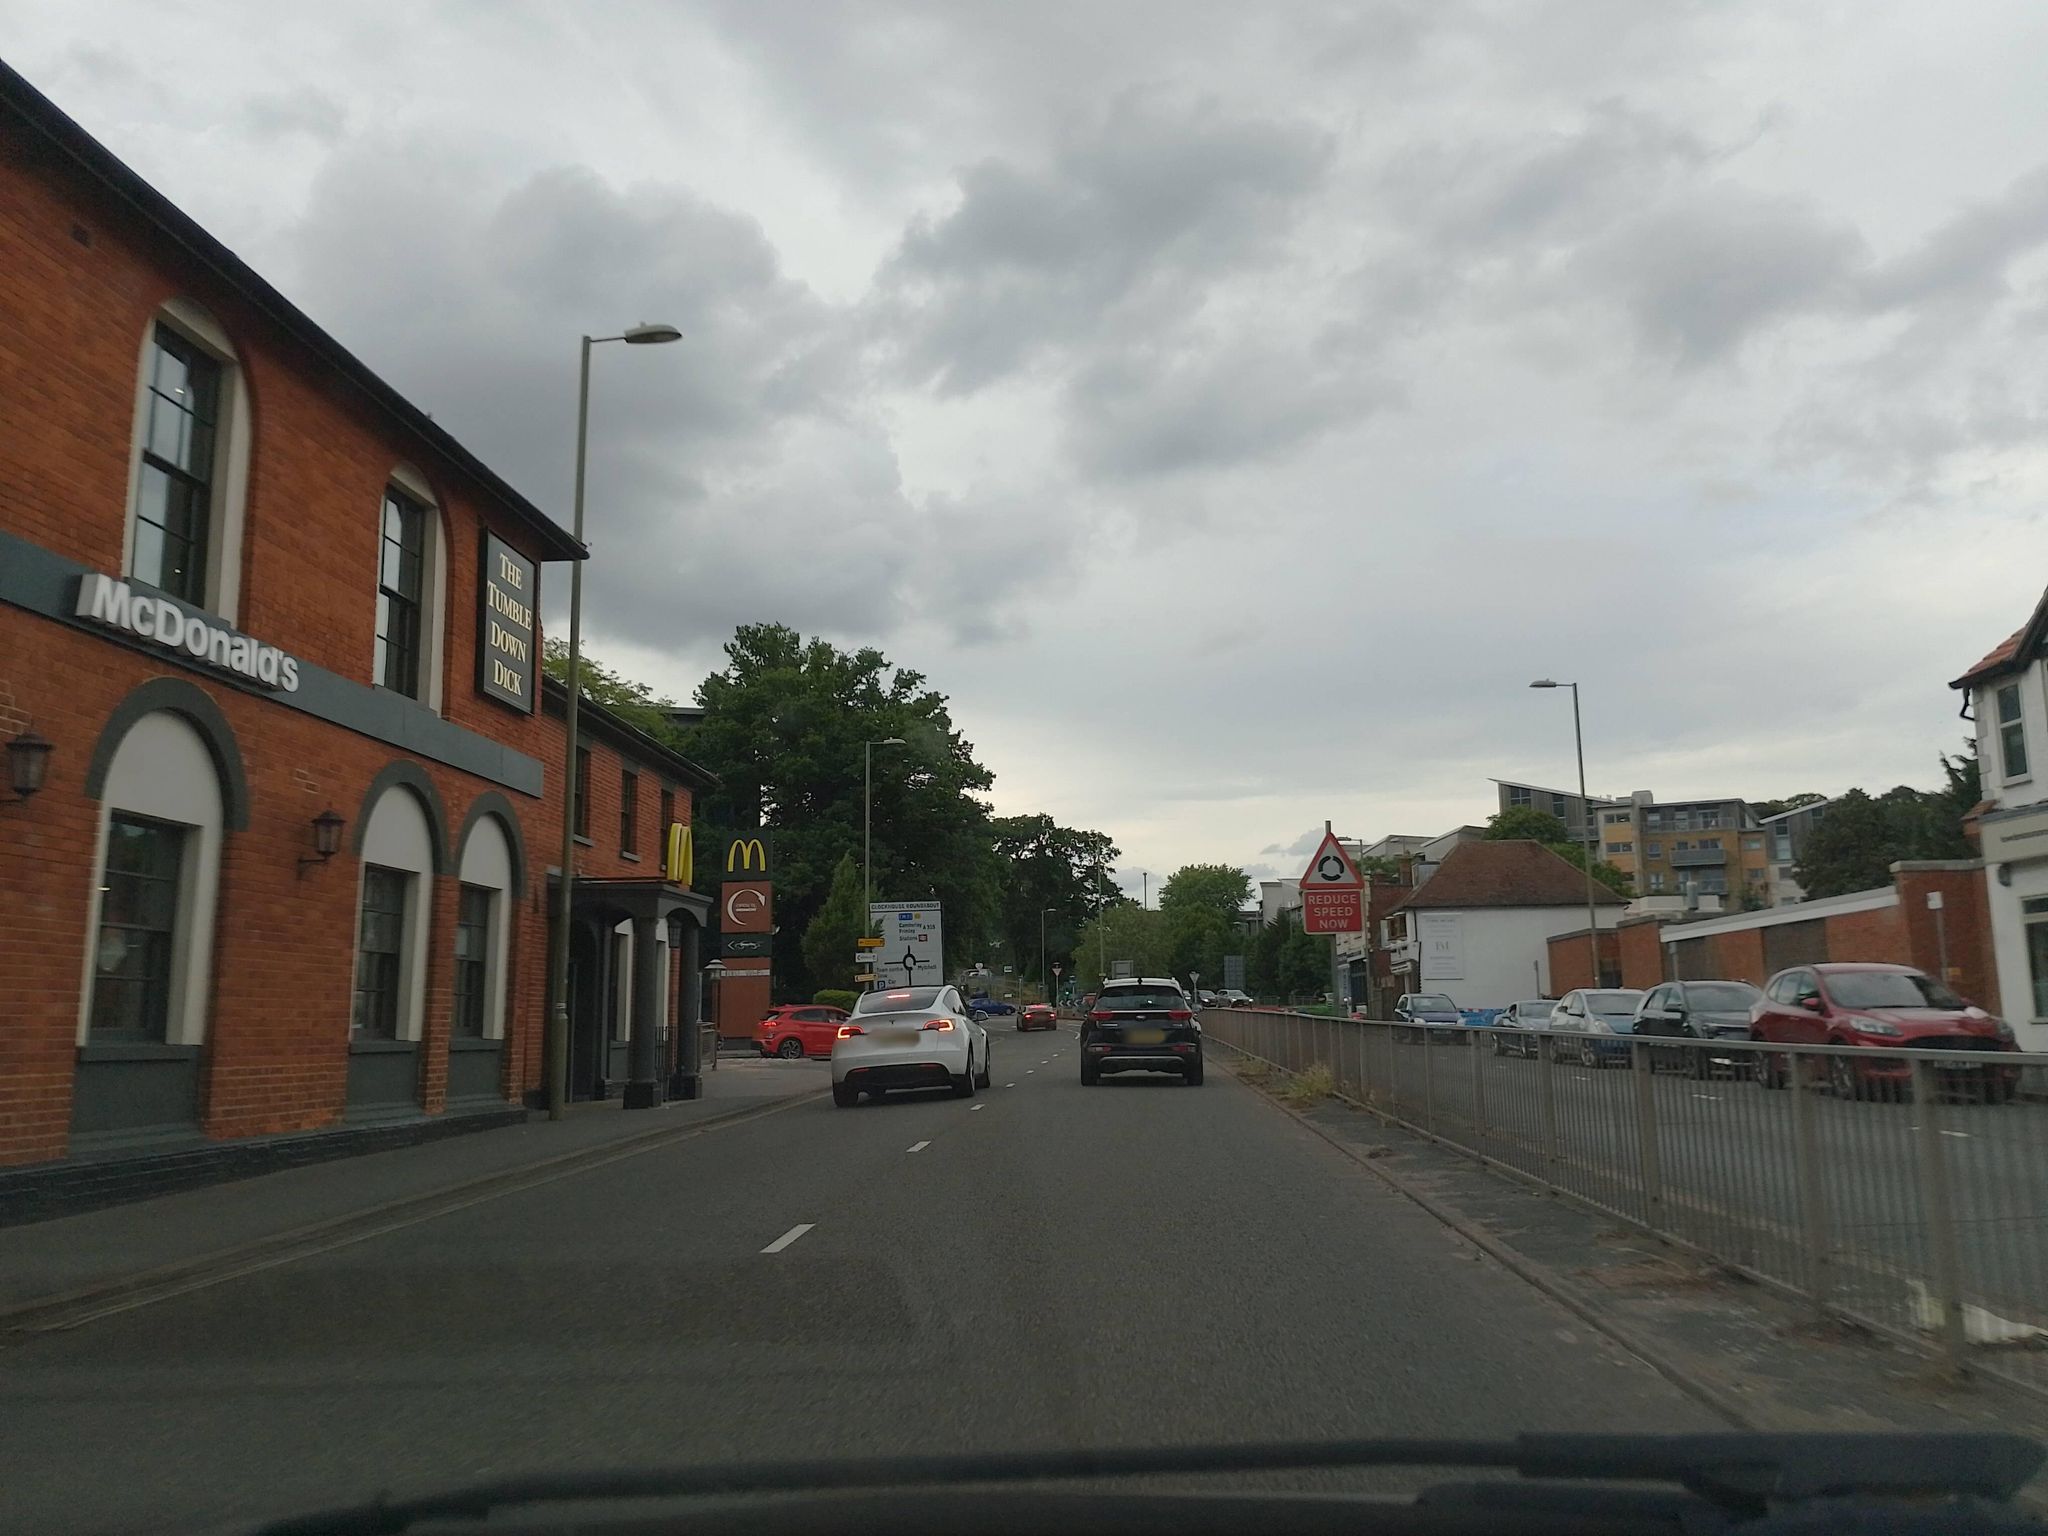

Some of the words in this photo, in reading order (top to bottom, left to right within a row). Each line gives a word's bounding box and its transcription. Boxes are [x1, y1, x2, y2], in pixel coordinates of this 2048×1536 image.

[499, 552, 523, 591] THE
[487, 580, 532, 631] TUMBLE
[77, 573, 299, 693] McDonald's
[490, 620, 527, 664] DOWN
[493, 658, 523, 697] DICK
[1307, 894, 1357, 905] REDUCE
[1313, 906, 1353, 917] SPEED
[1319, 919, 1349, 929] NOW
